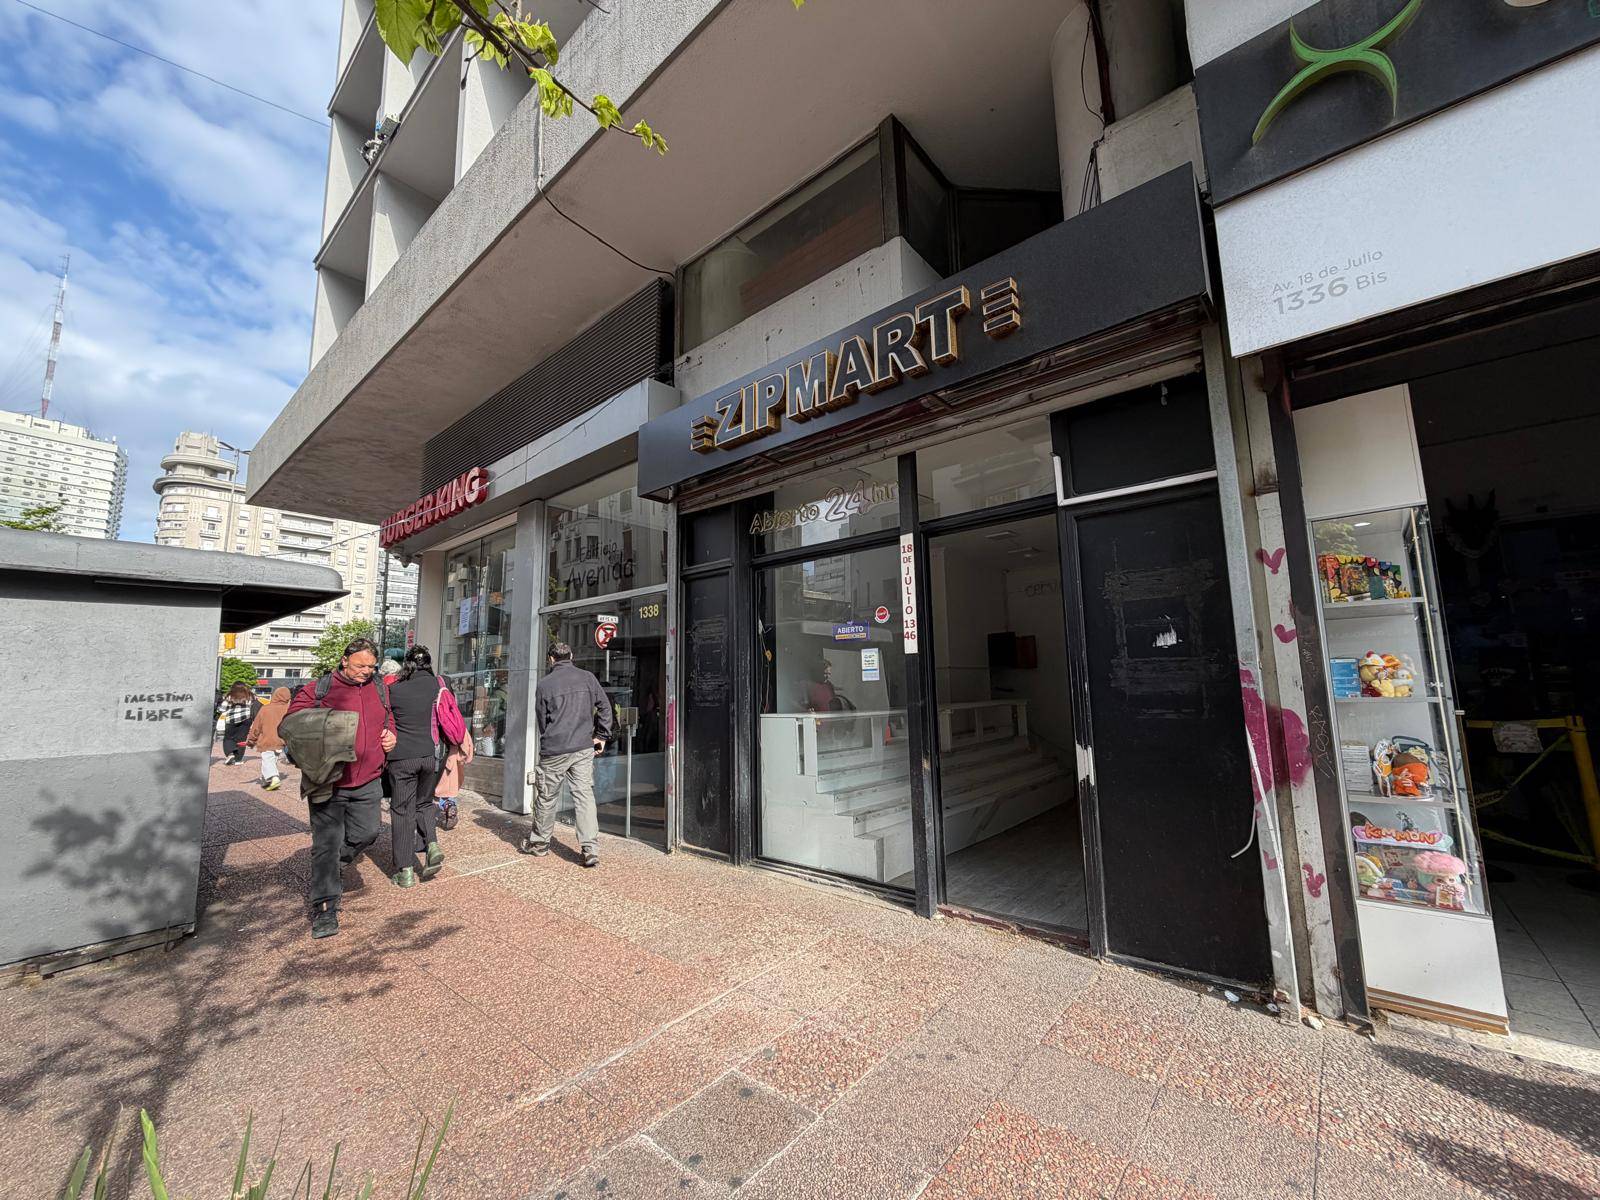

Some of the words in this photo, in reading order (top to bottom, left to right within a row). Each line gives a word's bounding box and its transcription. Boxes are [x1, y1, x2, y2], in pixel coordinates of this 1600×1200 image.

[1299, 272, 1314, 286] 18
[1318, 265, 1339, 279] de
[1344, 251, 1384, 271] Julio
[1273, 276, 1349, 315] 1336
[1355, 270, 1388, 291] Bis
[714, 283, 970, 448] ZIPMART
[379, 493, 435, 550] BURGER
[434, 466, 489, 520] KING
[749, 503, 821, 535] Abierto
[824, 478, 871, 523] 24
[901, 543, 913, 554] 18
[902, 555, 912, 564] DE
[566, 551, 634, 589] Avenida
[904, 566, 913, 615] JULIO
[639, 603, 660, 619] 1338
[837, 625, 864, 634] ABIERTO
